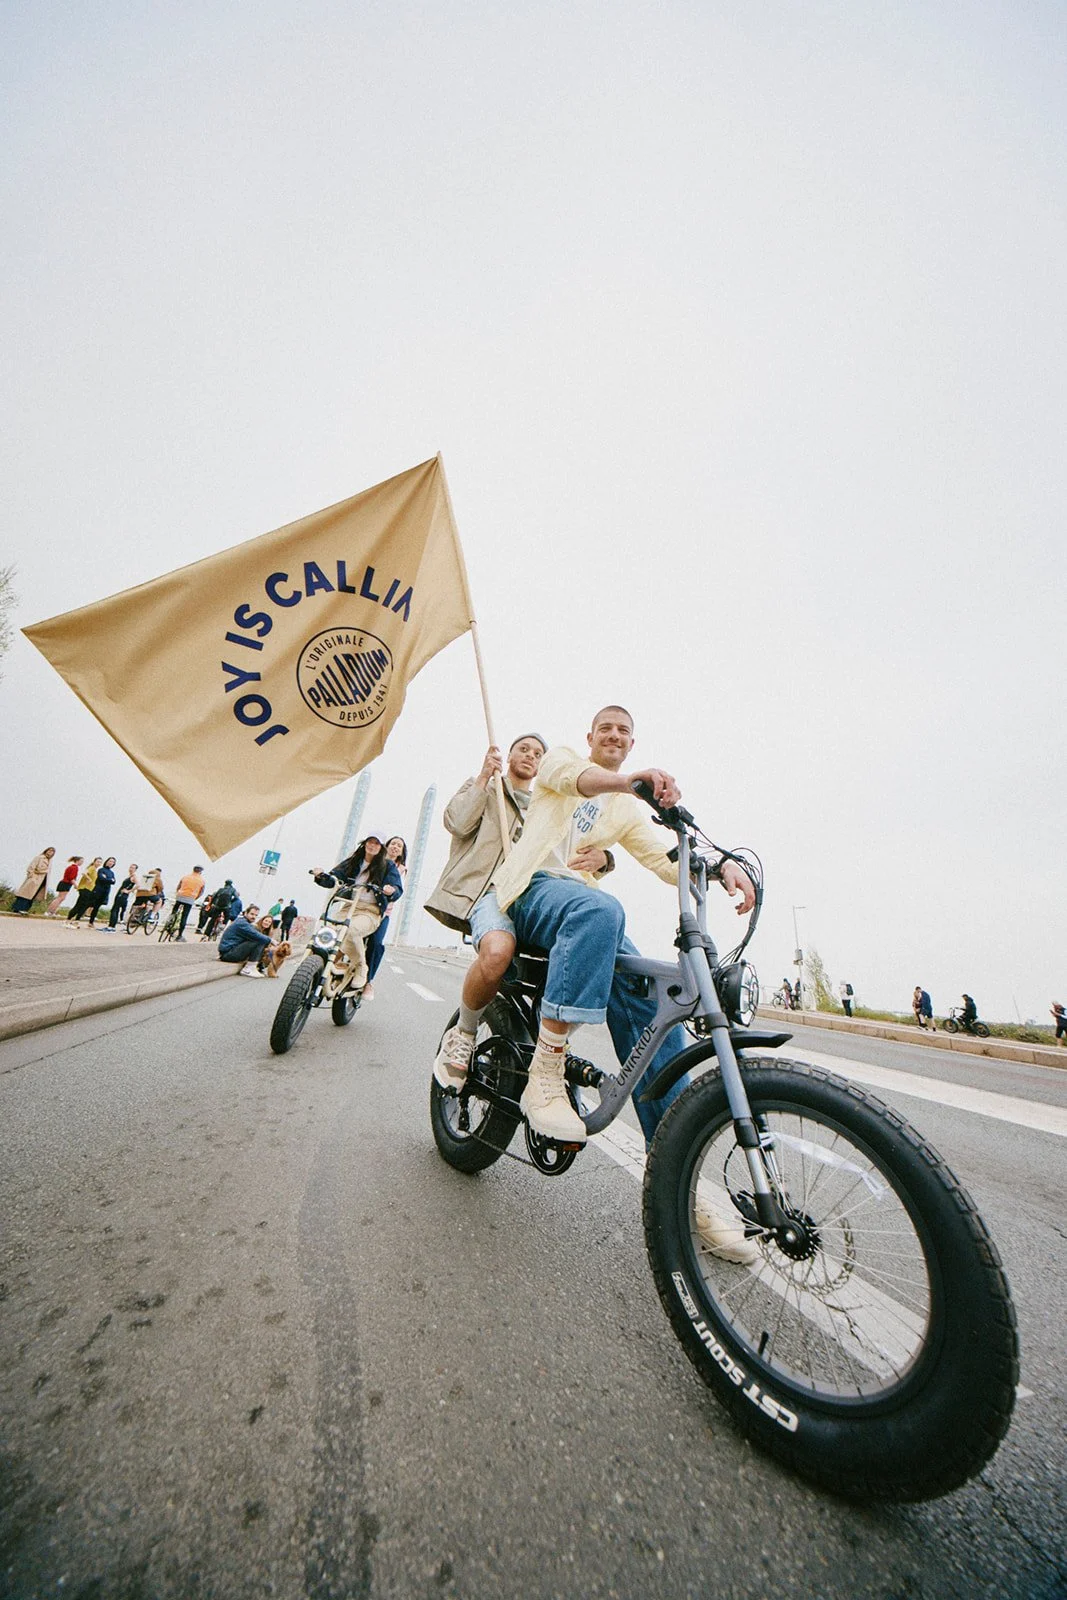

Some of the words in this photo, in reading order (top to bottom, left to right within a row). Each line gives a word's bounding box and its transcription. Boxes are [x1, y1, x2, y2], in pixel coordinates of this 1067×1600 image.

[225, 603, 273, 651] IS
[305, 634, 364, 670] L'ORIGINALE
[221, 661, 290, 746] JOY
[307, 648, 389, 709] PALLADIUM
[339, 706, 374, 722] DEPUIS
[373, 683, 388, 708] 1947
[616, 1023, 658, 1087] UNIKRIDE
[692, 1320, 746, 1386] SCOUT
[742, 1383, 799, 1433] CST
